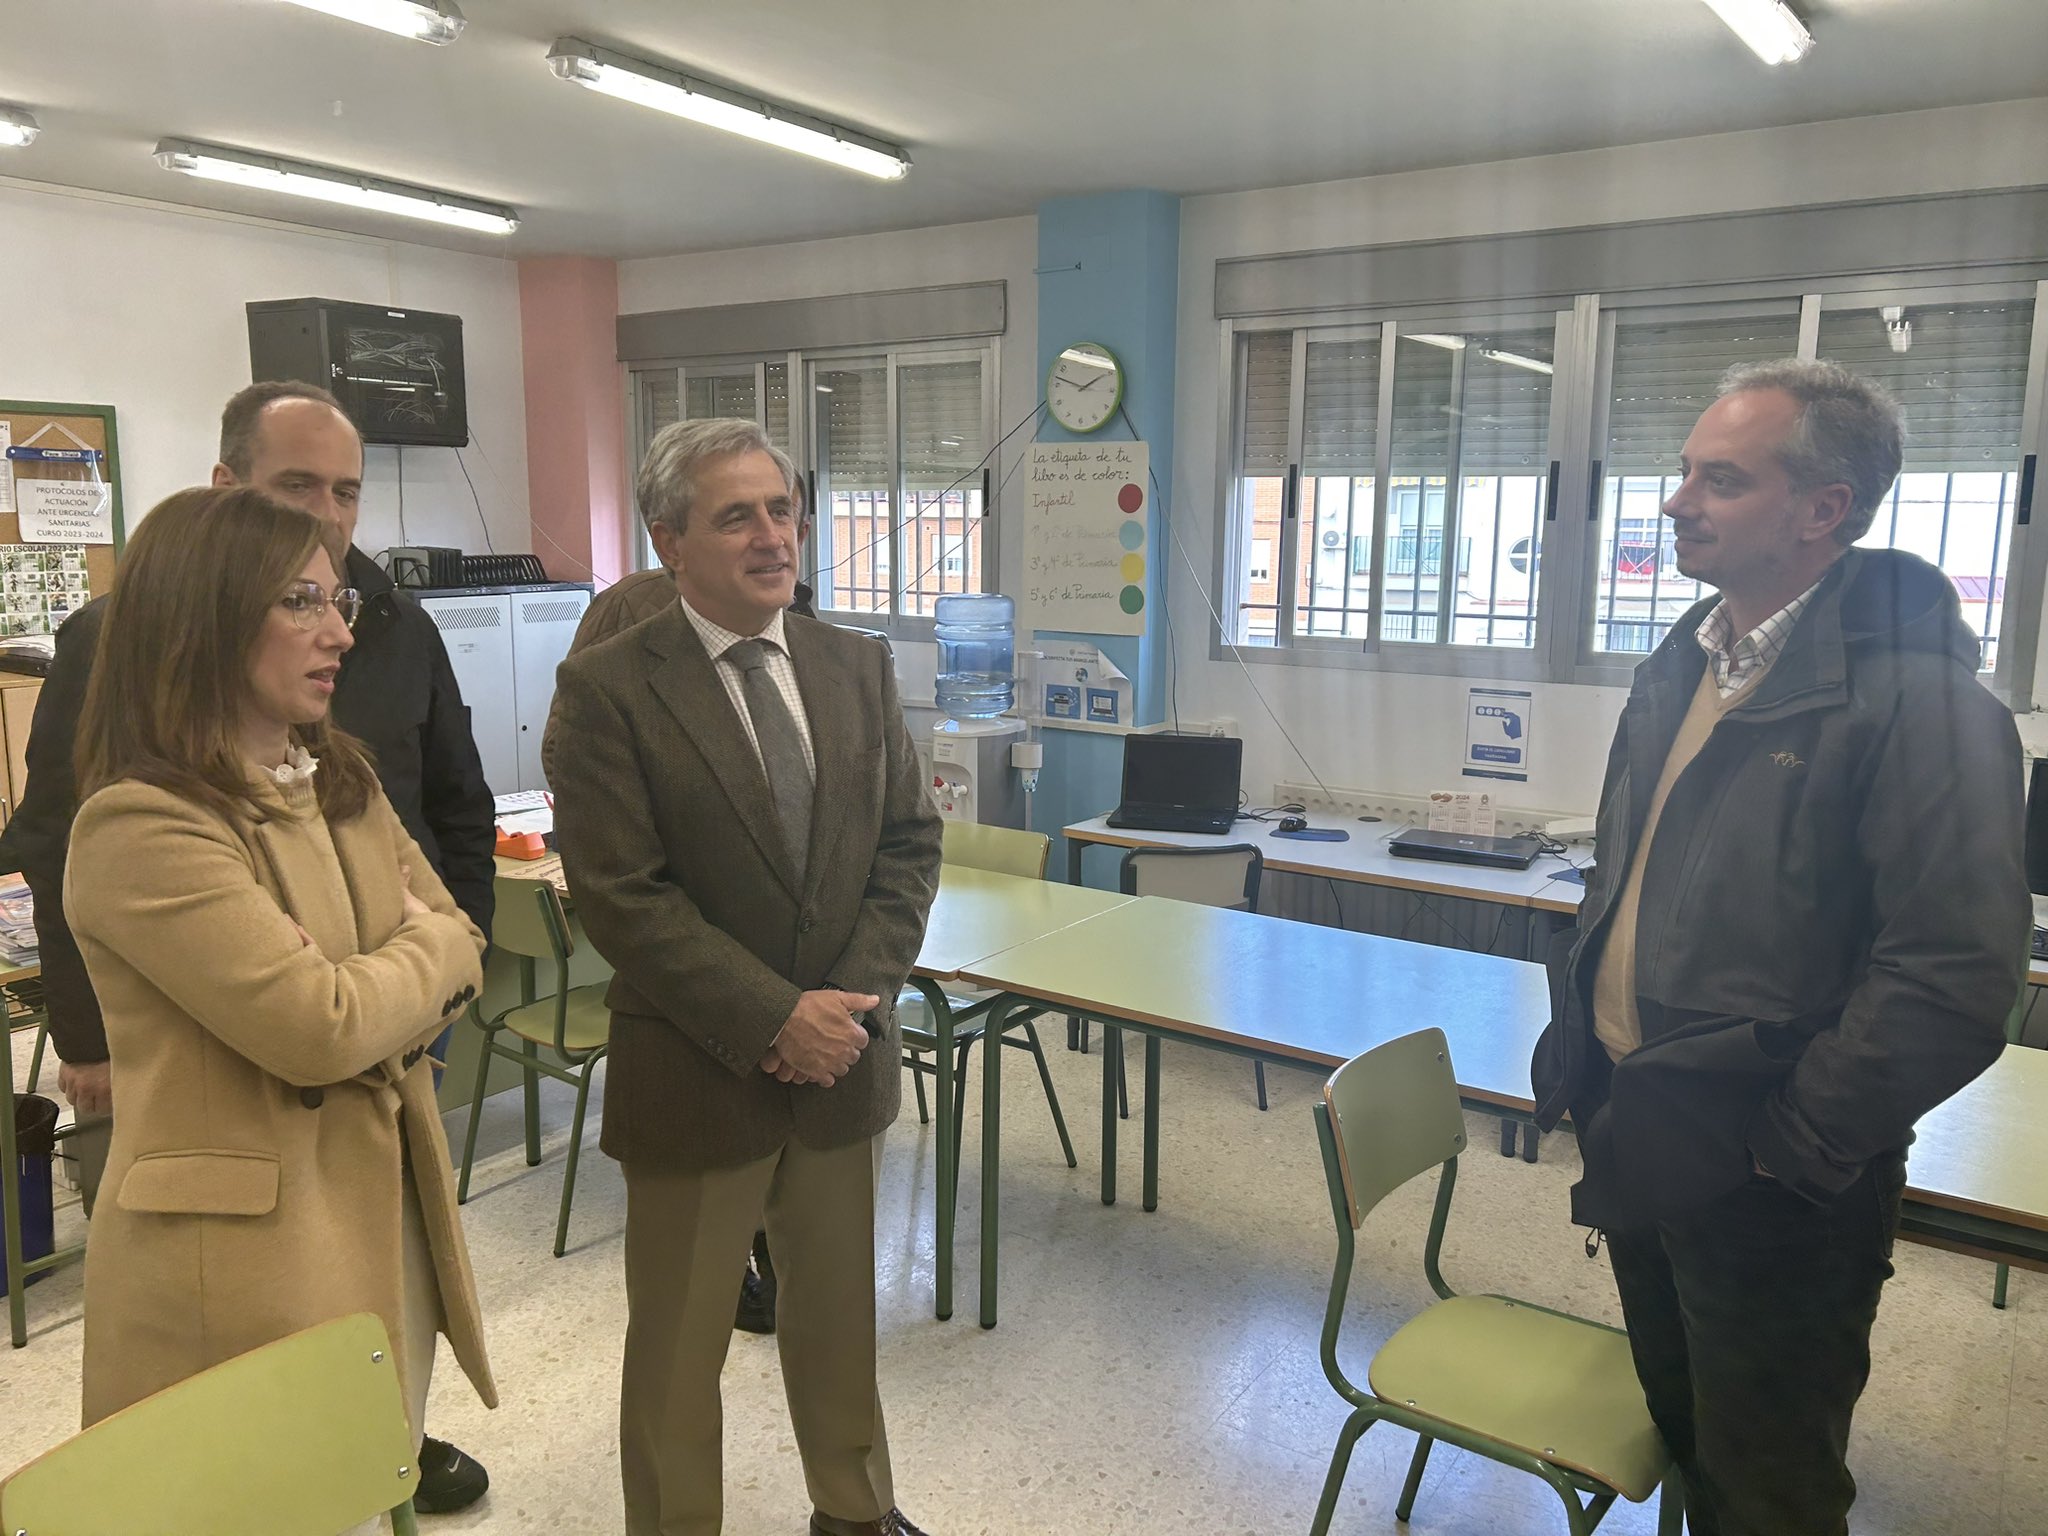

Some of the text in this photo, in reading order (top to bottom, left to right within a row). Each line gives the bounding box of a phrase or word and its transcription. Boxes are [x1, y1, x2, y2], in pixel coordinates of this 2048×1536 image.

[1033, 447, 1132, 469] La etiqueta de tu
[1031, 466, 1129, 481] libro es de color:
[36, 487, 98, 497] PROTOCOLOS DE
[45, 498, 88, 506] ACTUACIÓN
[37, 508, 100, 518] ANTE URGENCIAS
[48, 520, 91, 528] SANITARIAS
[64, 530, 104, 538] 2023-2024
[1041, 594, 1048, 607] y
[1061, 586, 1072, 599] de
[1072, 583, 1114, 599] Primaria
